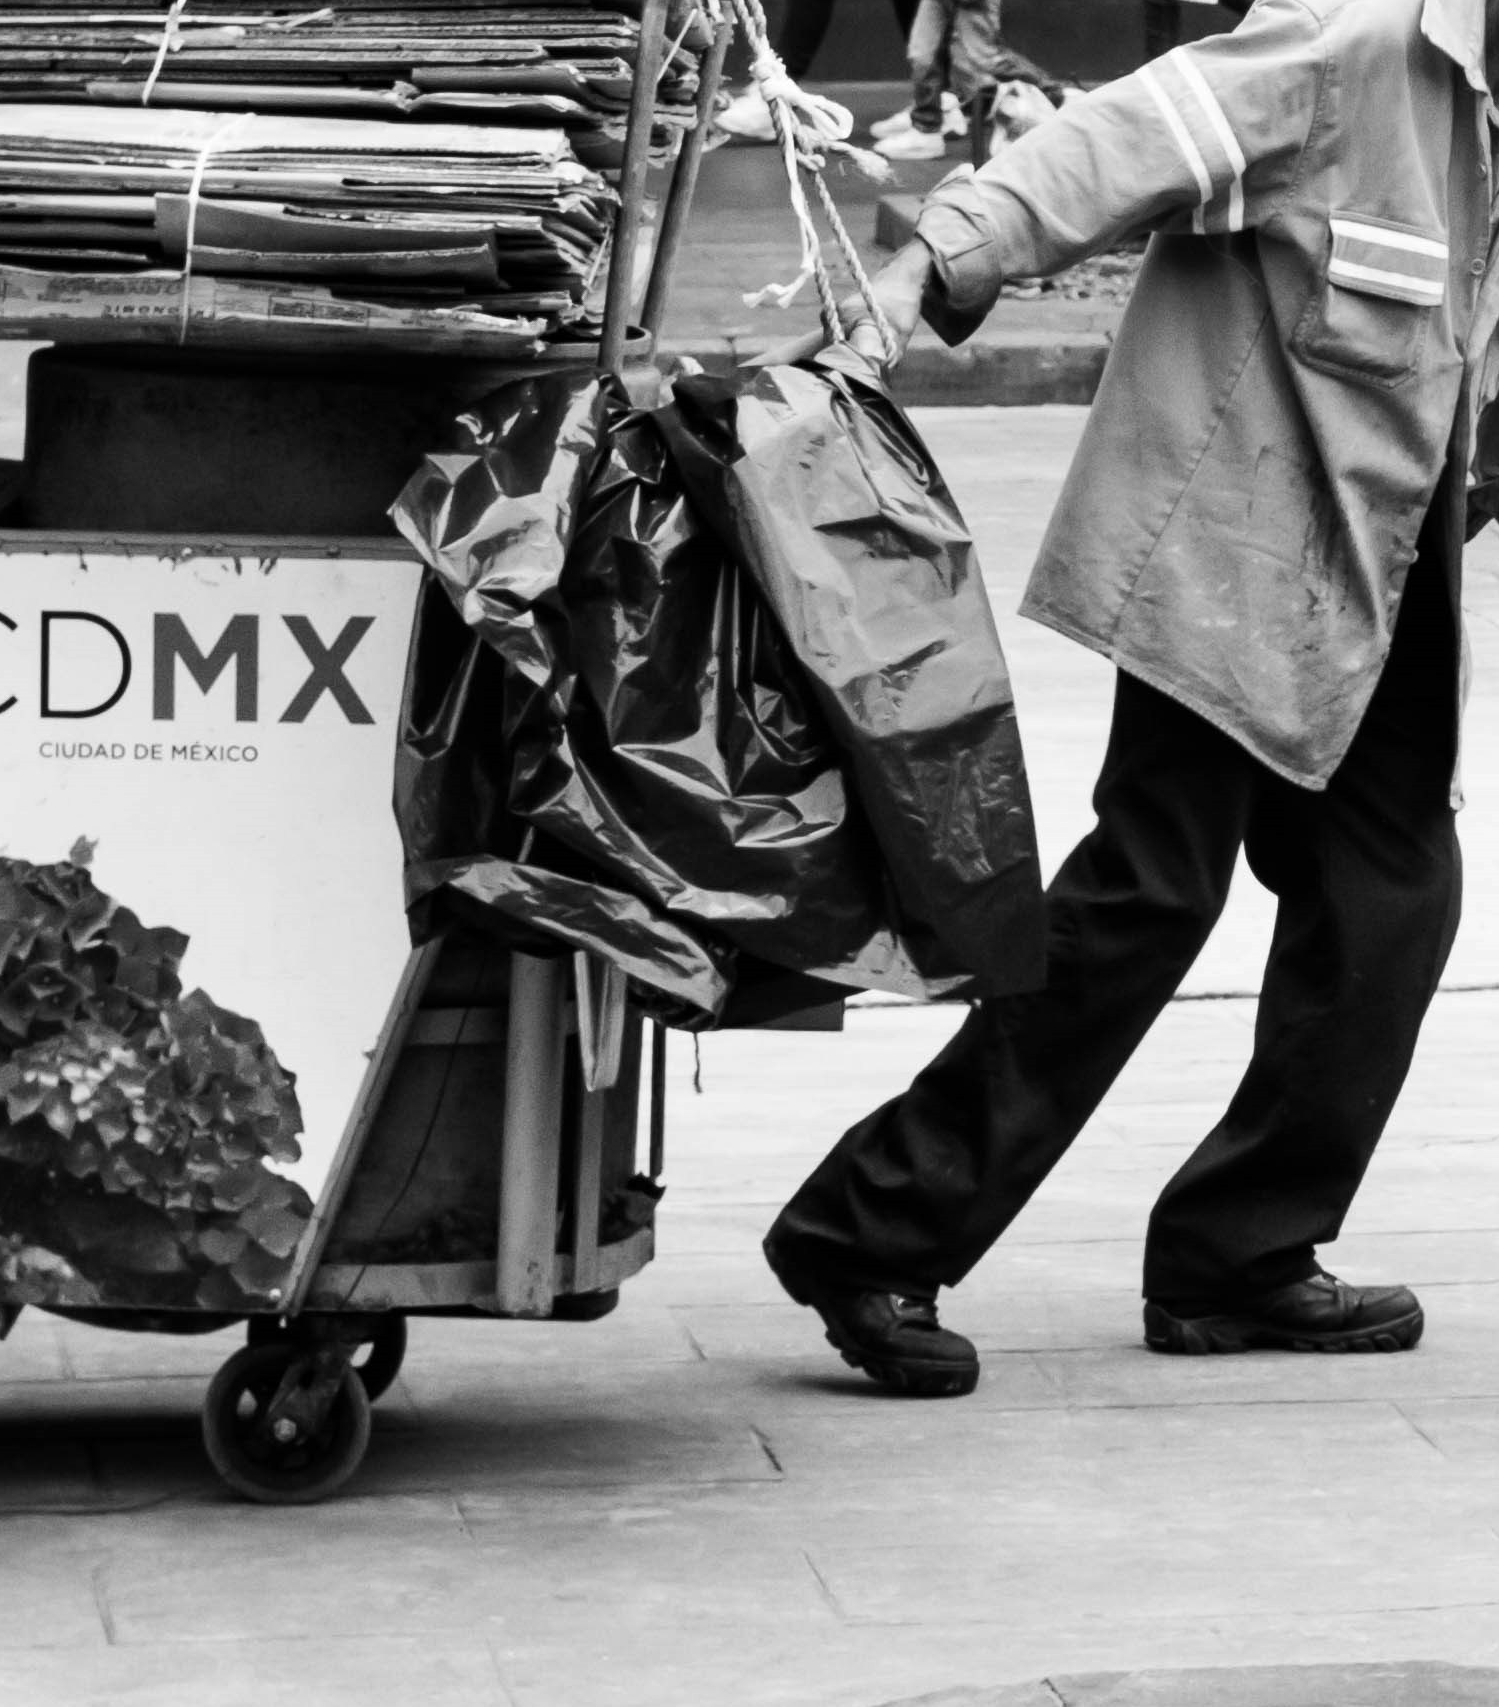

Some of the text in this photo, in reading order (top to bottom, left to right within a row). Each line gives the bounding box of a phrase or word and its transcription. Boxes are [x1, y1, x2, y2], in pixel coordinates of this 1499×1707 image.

[38, 739, 260, 763] CIUDAD DE MÉXICO
